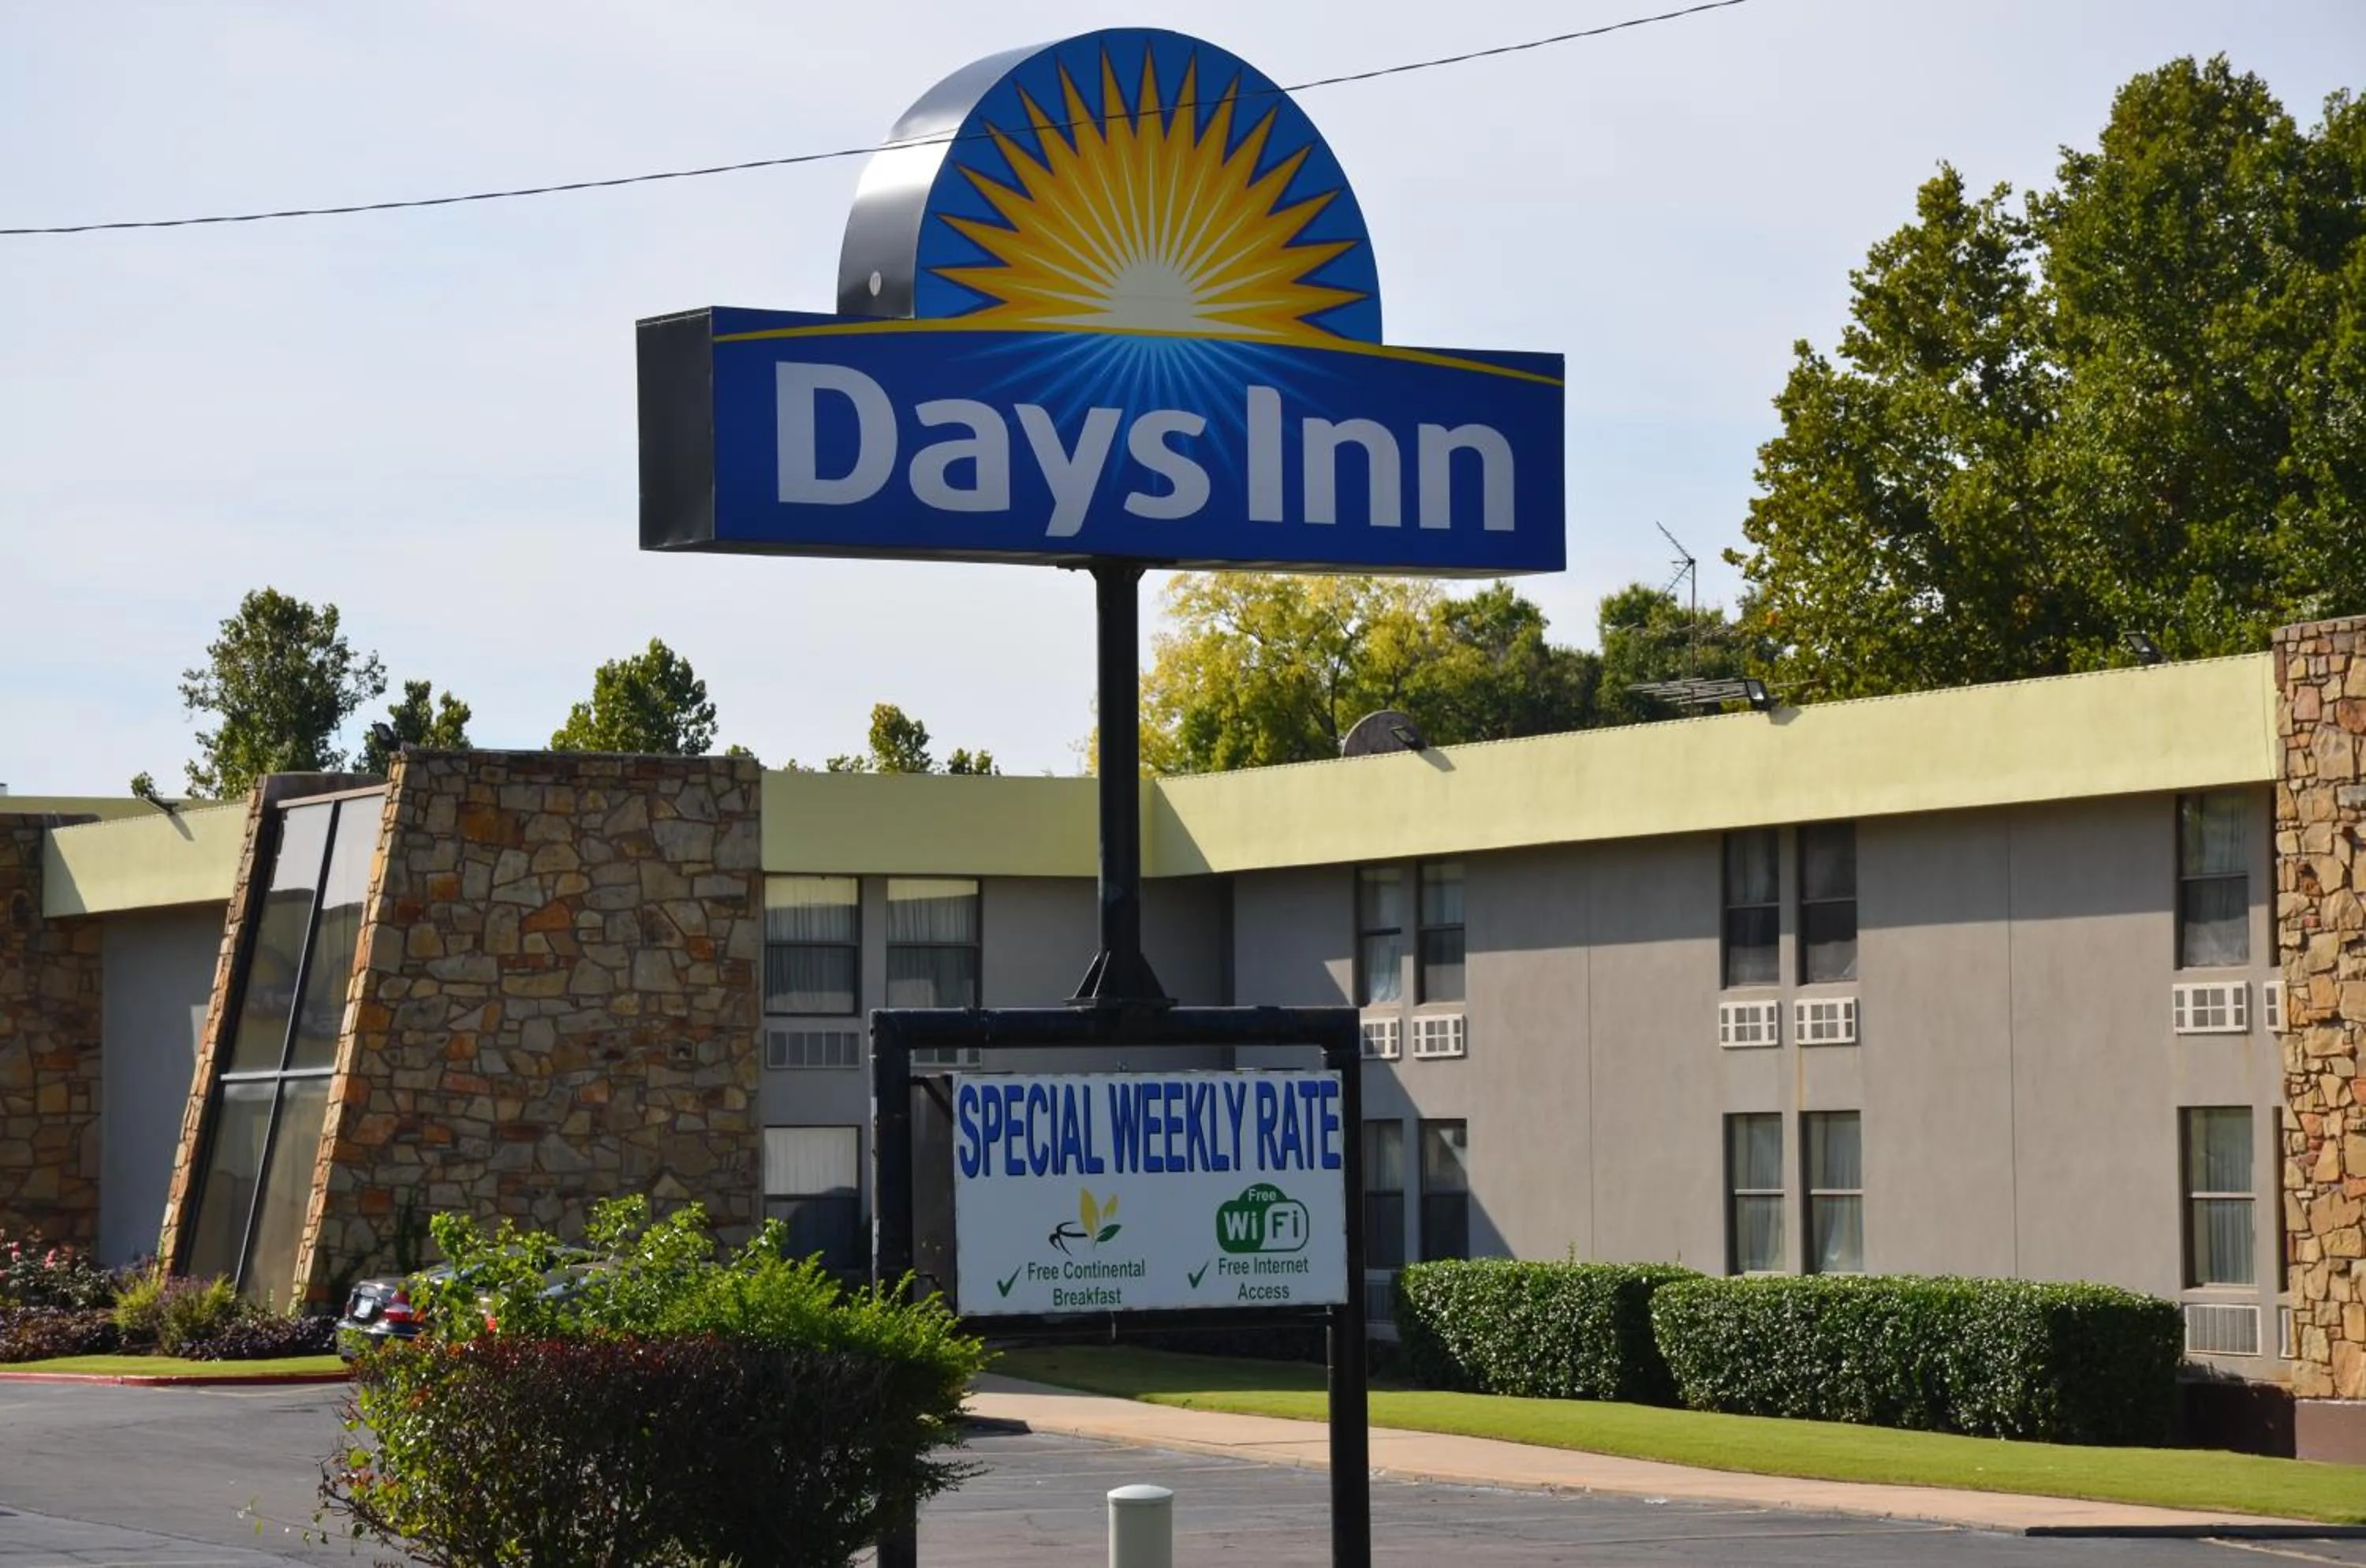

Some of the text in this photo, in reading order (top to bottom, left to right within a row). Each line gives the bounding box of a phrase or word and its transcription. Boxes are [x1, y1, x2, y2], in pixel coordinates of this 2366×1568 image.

[775, 360, 1515, 537] Days Inn
[958, 1080, 1341, 1178] SPECIAL WEEKLY RATE
[1248, 1189, 1277, 1202] Free
[1028, 1258, 1146, 1281] Free Continental
[1218, 1256, 1309, 1275] Free Internet
[1053, 1287, 1122, 1306] Breakfast
[1237, 1282, 1290, 1300] Access
